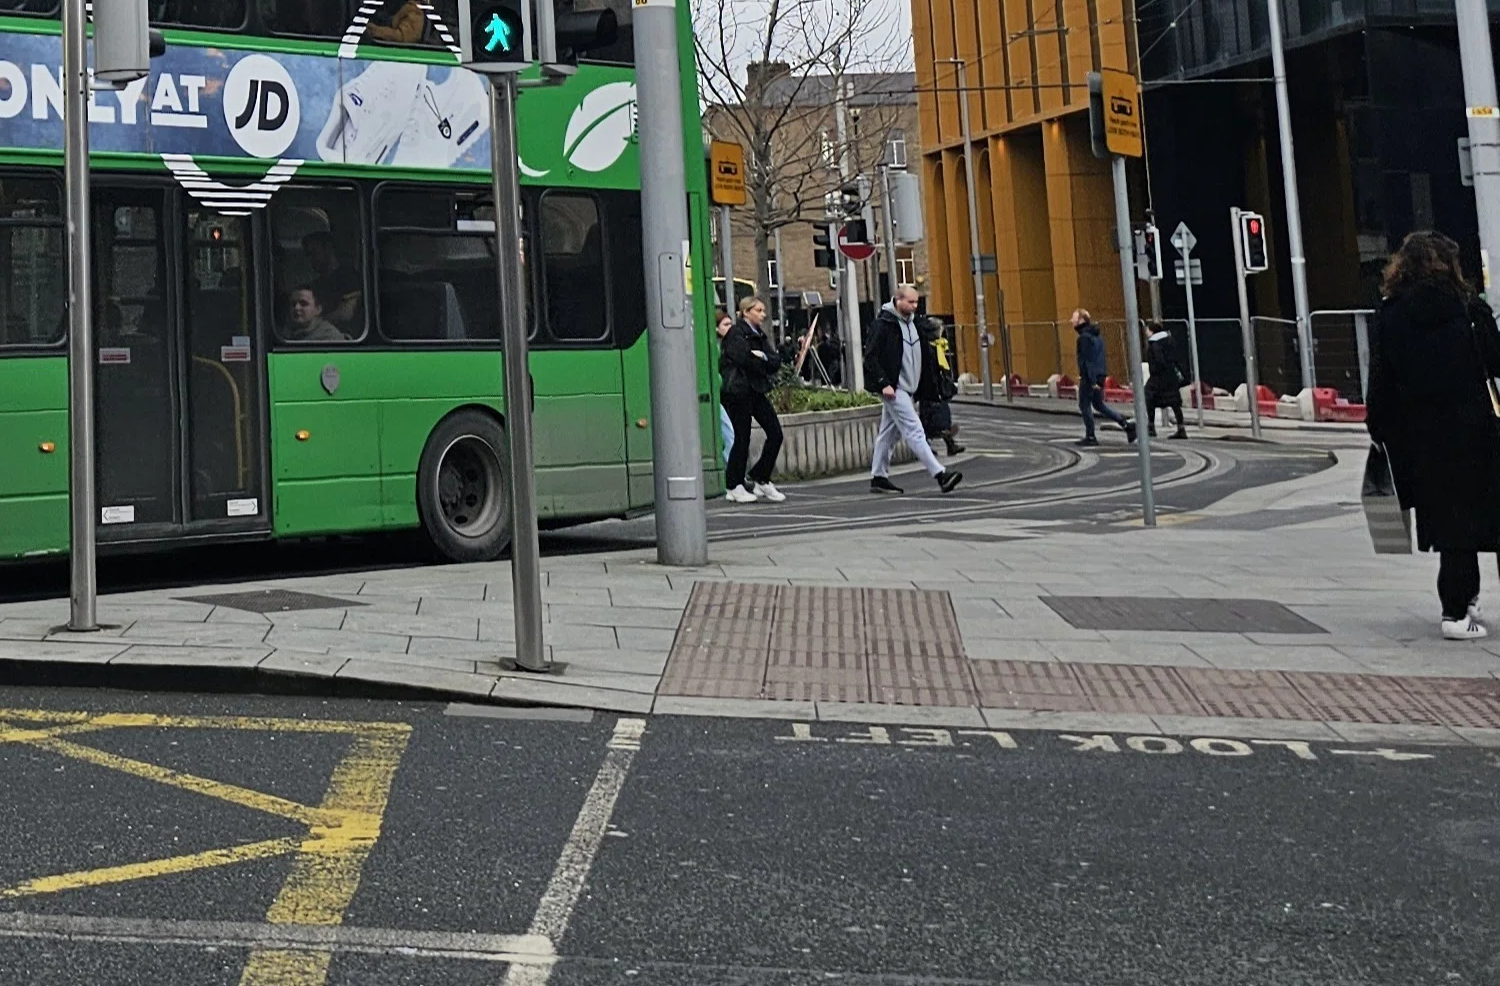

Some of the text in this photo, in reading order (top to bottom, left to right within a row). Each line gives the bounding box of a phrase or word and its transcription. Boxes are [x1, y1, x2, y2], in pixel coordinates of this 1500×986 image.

[150, 72, 206, 112] AT
[235, 79, 289, 131] JD
[774, 723, 1318, 760] LOOK LEFT
